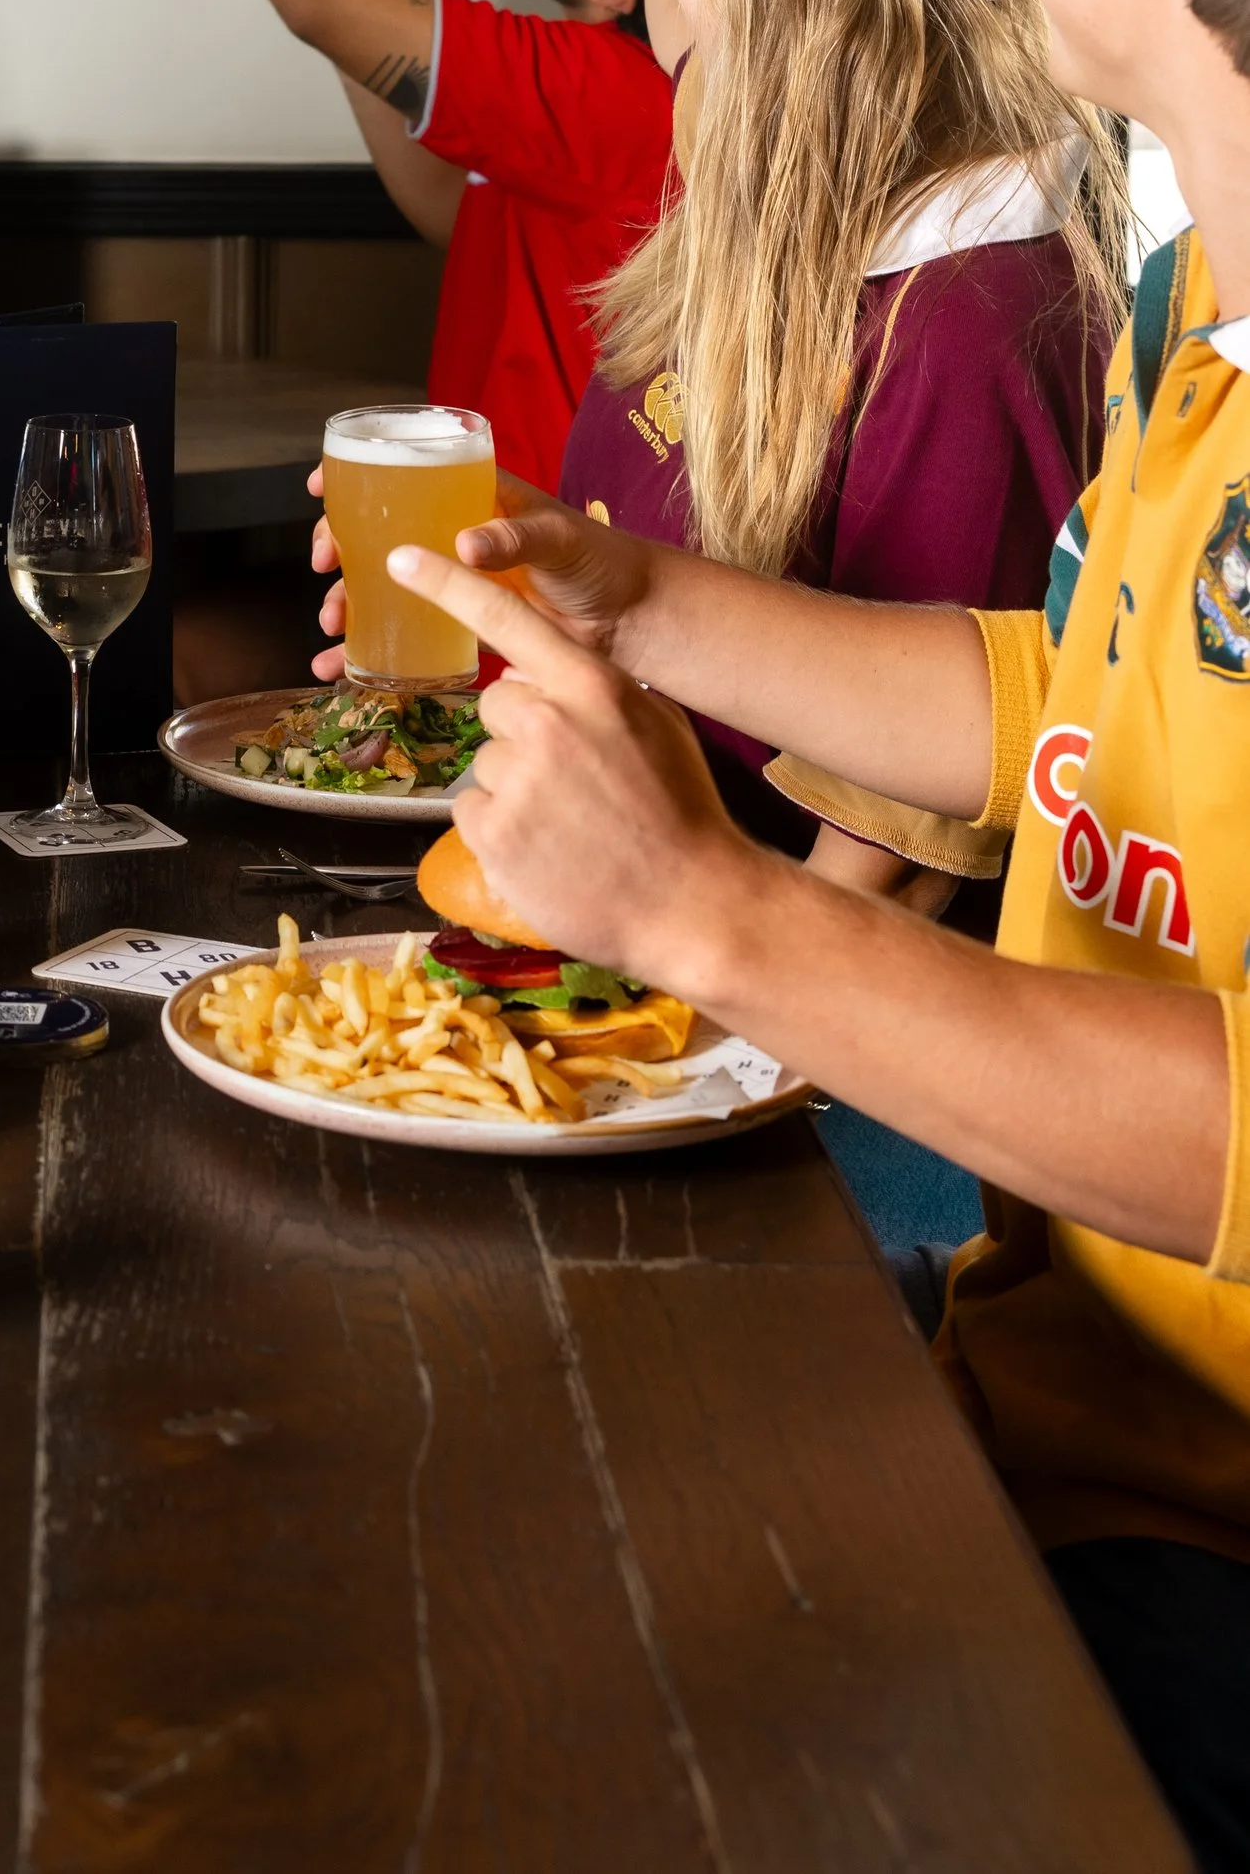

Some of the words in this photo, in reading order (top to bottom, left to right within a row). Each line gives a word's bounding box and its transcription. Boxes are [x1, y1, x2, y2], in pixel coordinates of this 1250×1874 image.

[628, 409, 669, 464] canterbury
[125, 939, 162, 953] B
[86, 960, 120, 971] 18
[160, 970, 192, 986] H
